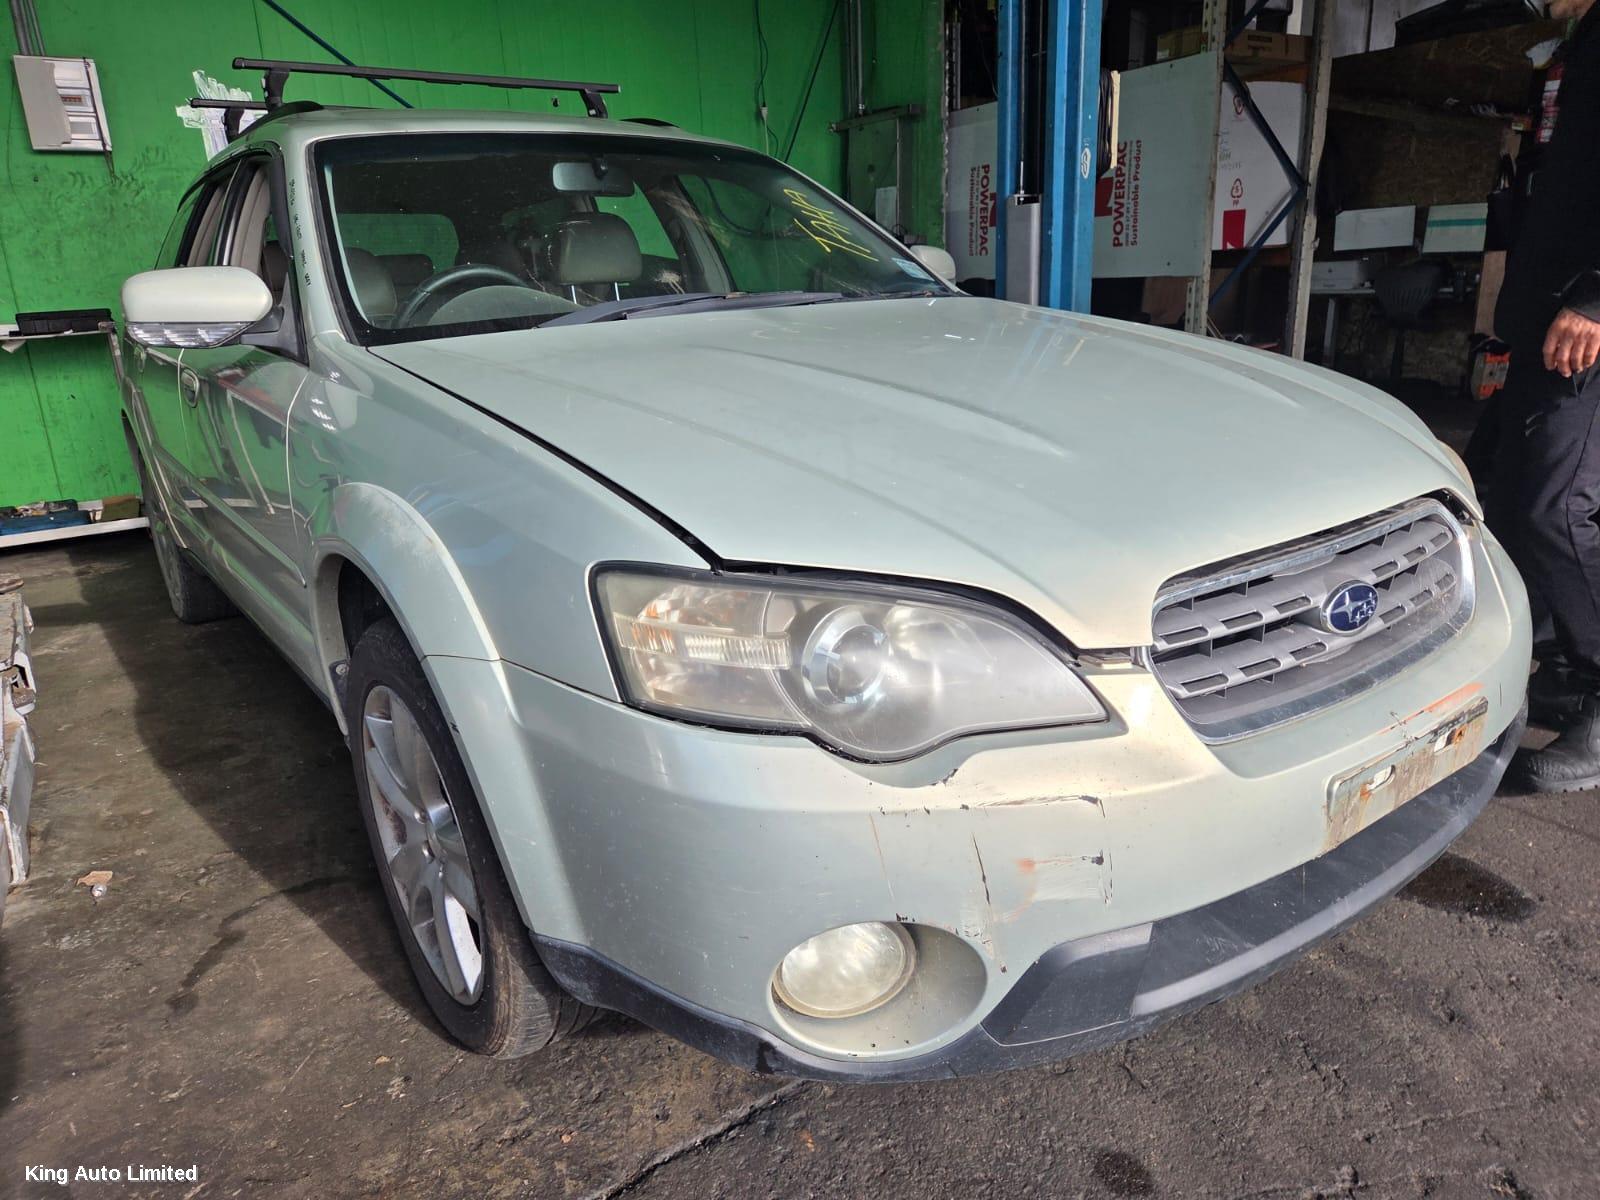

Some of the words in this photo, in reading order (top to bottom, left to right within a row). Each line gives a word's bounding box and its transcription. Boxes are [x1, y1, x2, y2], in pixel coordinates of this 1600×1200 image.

[1112, 140, 1127, 248] POWERPAC
[1132, 139, 1142, 181] Product
[980, 163, 990, 256] POWERPAC
[1131, 184, 1139, 247] Sustainable
